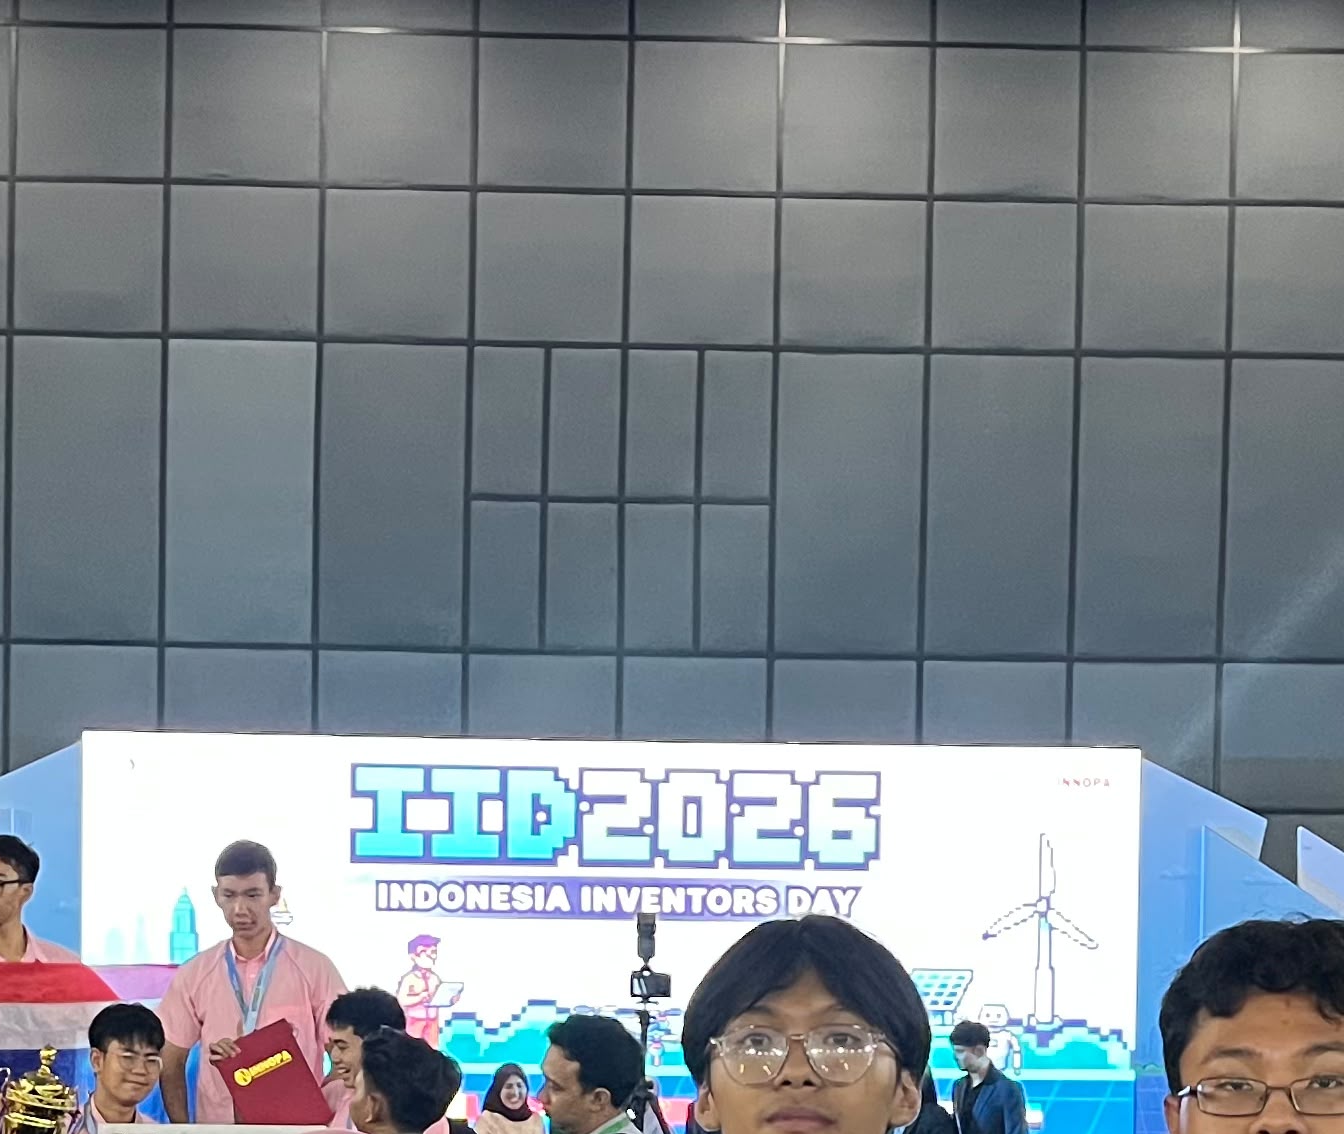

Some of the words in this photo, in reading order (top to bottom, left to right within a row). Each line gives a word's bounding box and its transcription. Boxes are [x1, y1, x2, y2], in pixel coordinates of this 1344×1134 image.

[376, 880, 570, 913] INDONESIA
[580, 884, 779, 916] INVENTORS
[785, 885, 862, 918] DAY
